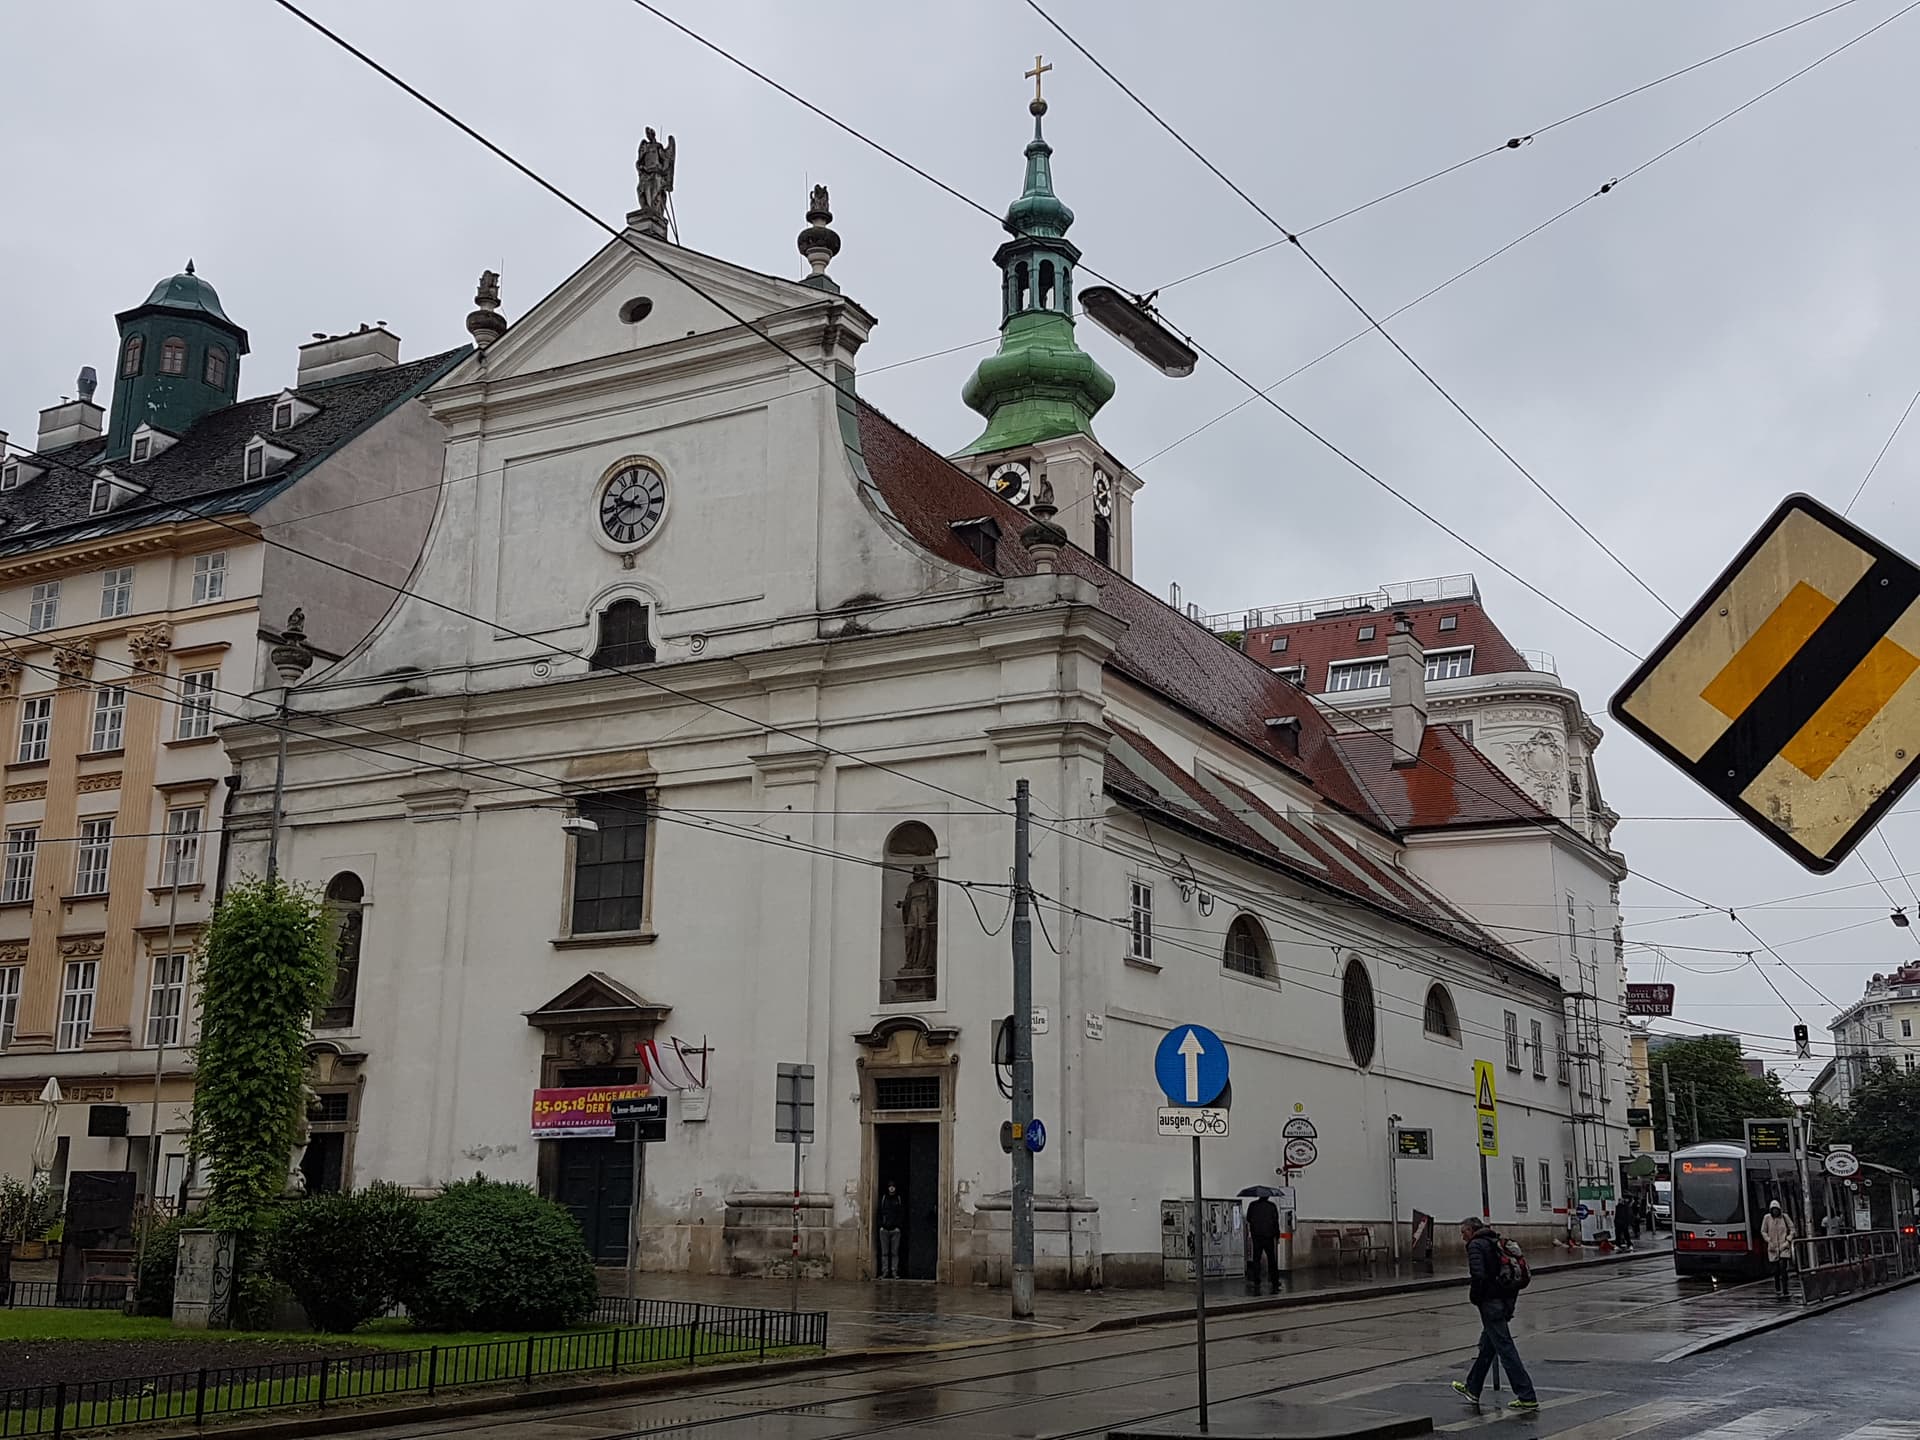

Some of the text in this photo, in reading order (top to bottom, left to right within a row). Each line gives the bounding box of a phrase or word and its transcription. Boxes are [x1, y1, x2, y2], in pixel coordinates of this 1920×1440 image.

[587, 1089, 648, 1102] LANGE NACHT
[534, 1096, 586, 1114] 25.05.18
[585, 1103, 604, 1113] DER
[1159, 1115, 1193, 1129] ausgen.
